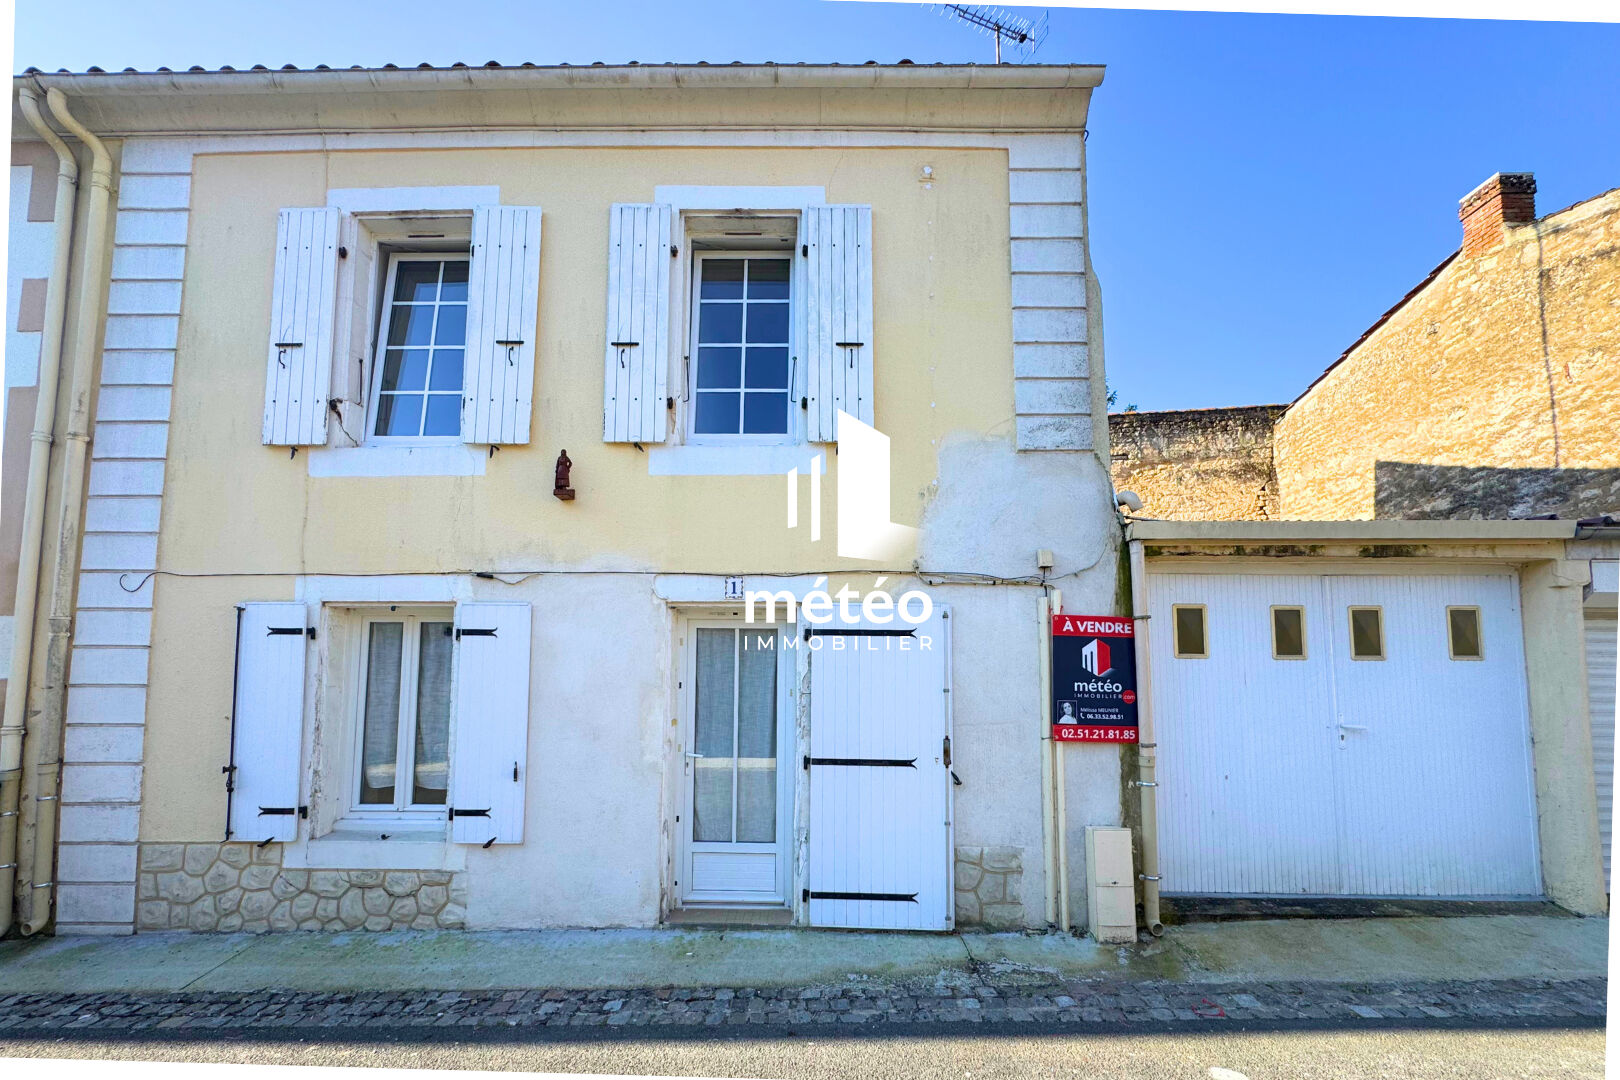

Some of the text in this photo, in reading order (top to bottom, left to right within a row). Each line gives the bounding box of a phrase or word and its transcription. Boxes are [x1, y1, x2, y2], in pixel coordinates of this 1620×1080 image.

[731, 581, 737, 595] 1
[1062, 616, 1132, 634] À VENDRE
[1074, 679, 1122, 692] météo
[1061, 728, 1136, 740] 02.51.21.81.85
